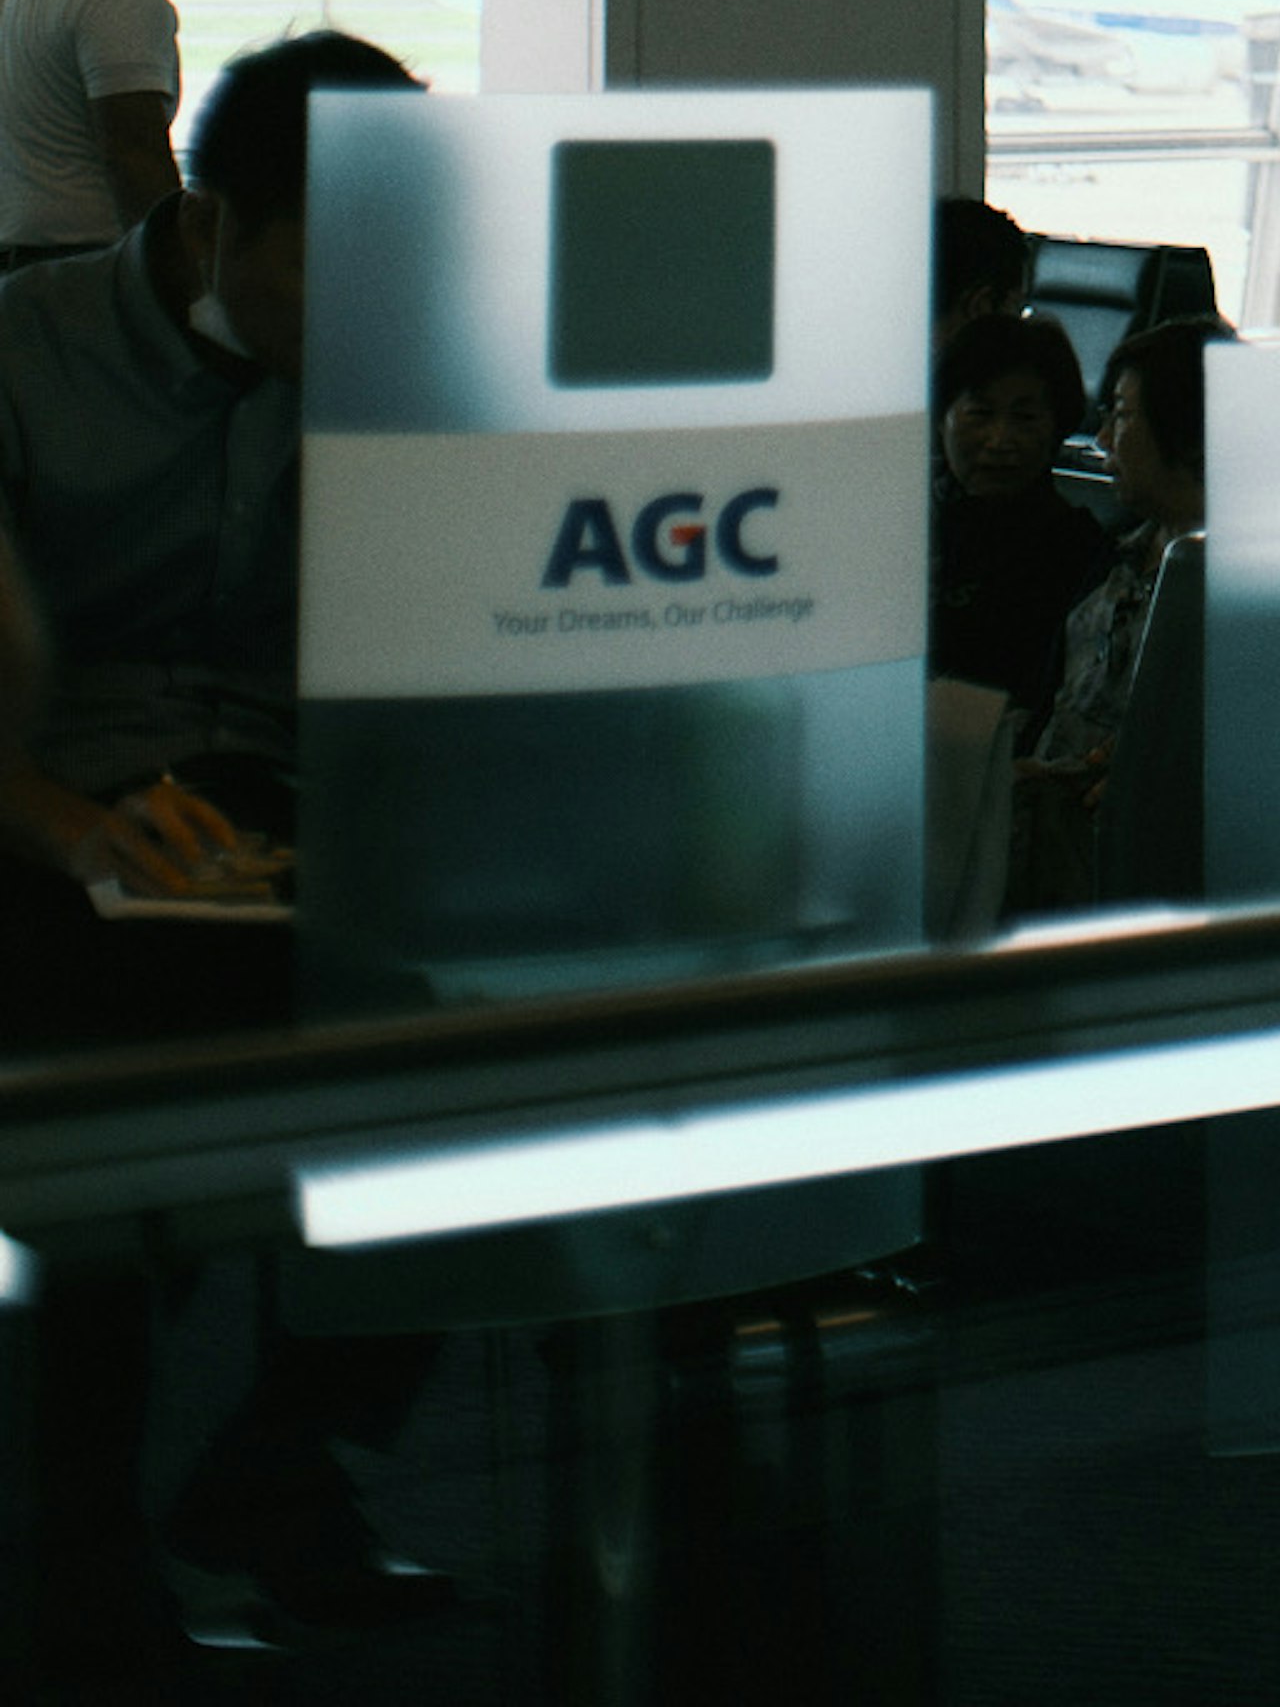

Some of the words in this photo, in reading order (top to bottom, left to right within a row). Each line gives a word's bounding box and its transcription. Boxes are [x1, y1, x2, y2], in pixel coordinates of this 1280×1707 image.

[540, 487, 779, 589] AGC
[493, 609, 548, 637] Your
[558, 607, 657, 634] Dreams,
[664, 602, 706, 628] Our
[713, 594, 815, 624] Challenge
